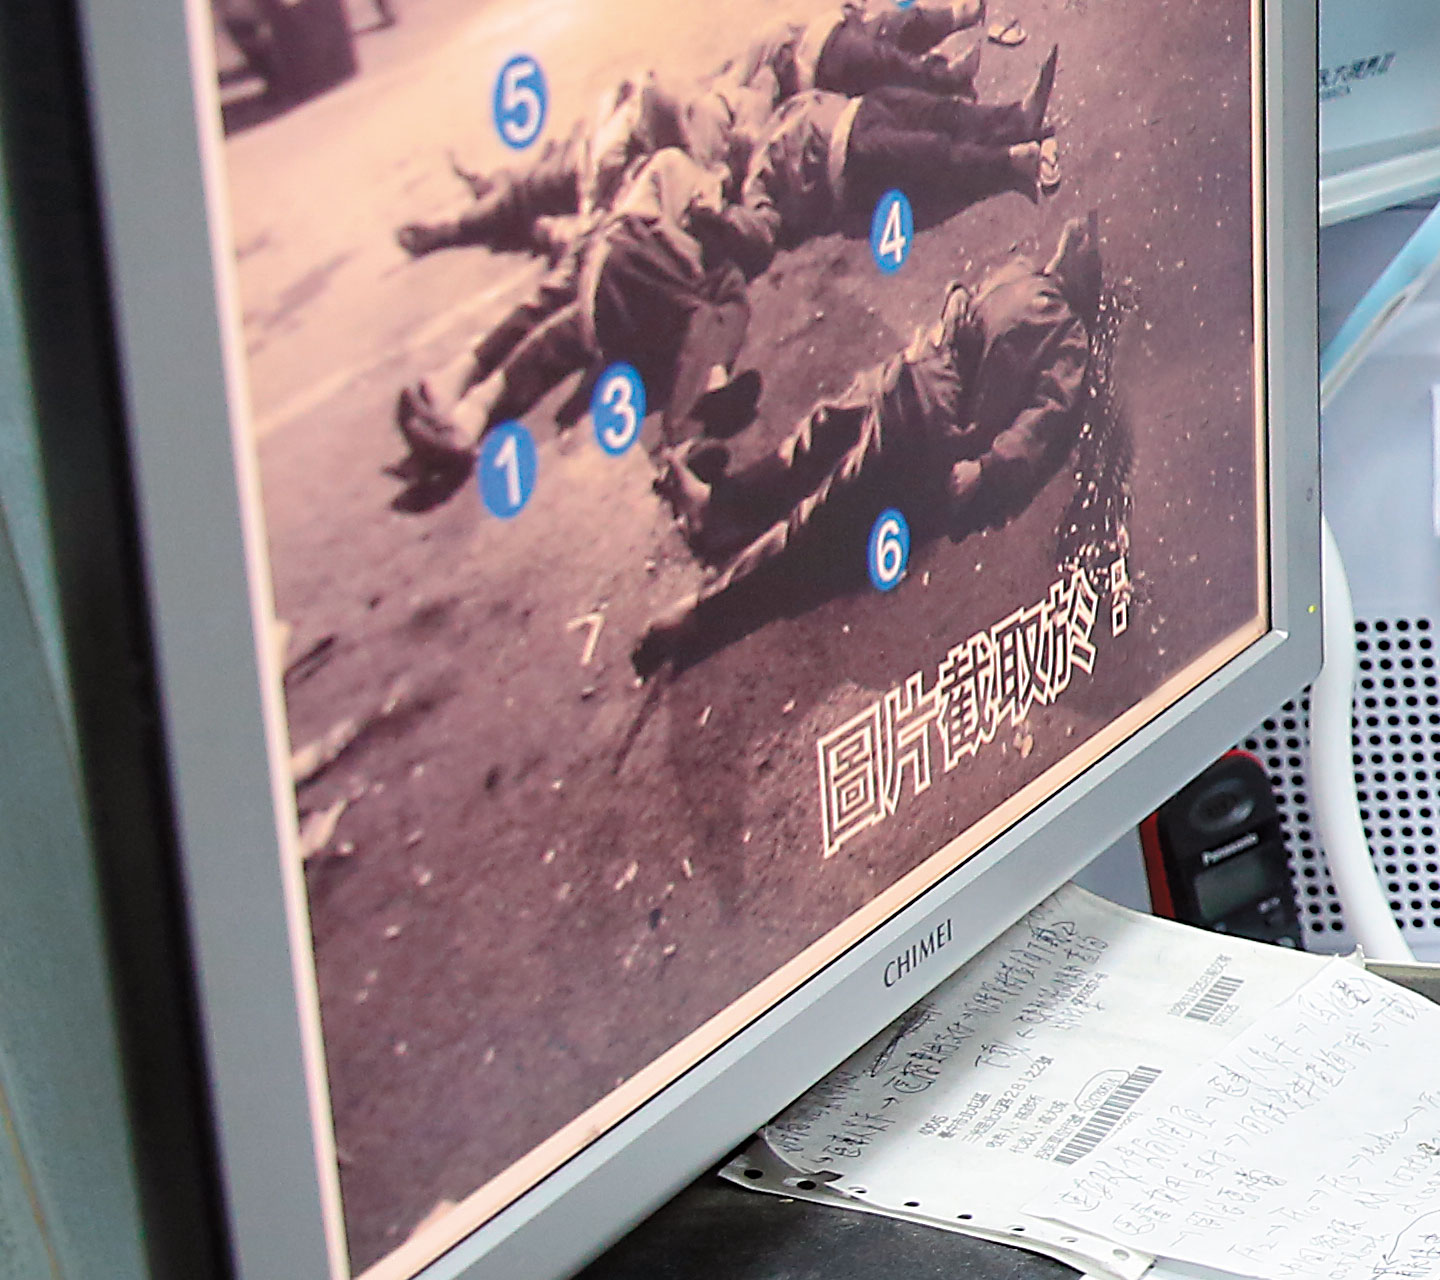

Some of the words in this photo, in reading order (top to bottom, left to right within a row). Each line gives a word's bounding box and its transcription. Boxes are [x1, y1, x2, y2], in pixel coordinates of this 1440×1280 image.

[503, 67, 538, 135] 5
[876, 202, 906, 262] 4
[601, 375, 635, 446] 3
[493, 432, 521, 505] 1
[874, 518, 903, 583] 6
[883, 919, 953, 988] CHIMEI
